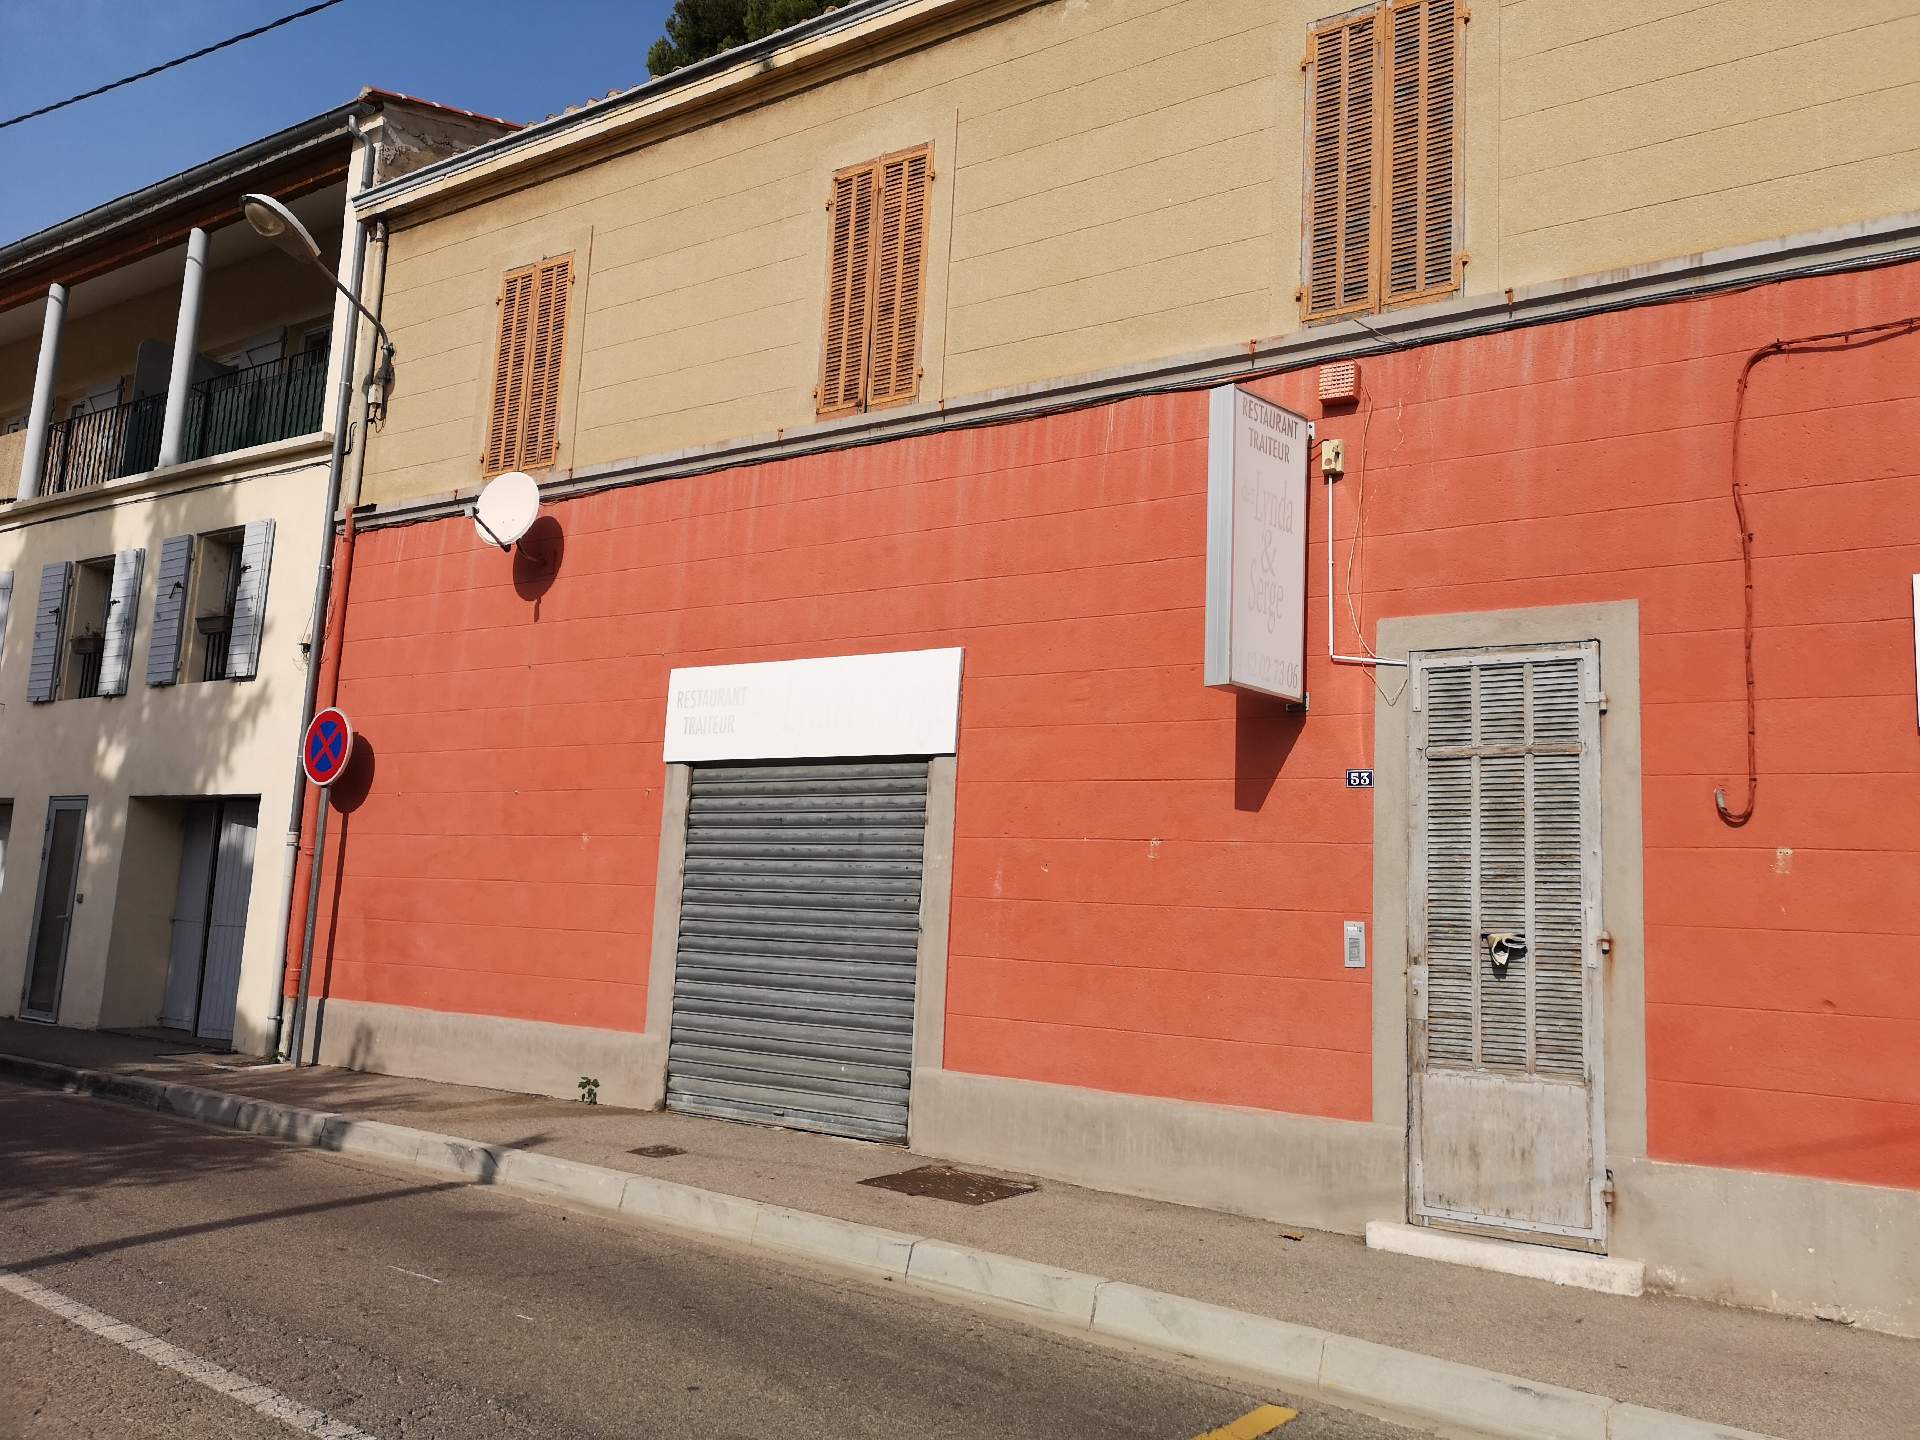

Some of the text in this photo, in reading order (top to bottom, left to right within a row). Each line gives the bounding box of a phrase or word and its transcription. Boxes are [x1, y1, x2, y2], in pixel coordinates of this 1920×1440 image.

[1242, 396, 1298, 440] RESTAURANT
[1248, 427, 1290, 464] TRAITEUR
[1253, 469, 1293, 535] Lynda
[1260, 529, 1277, 577] &
[1248, 559, 1284, 635] Serge
[1286, 662, 1299, 689] 06
[676, 685, 748, 710] RESTAURANT
[682, 714, 736, 736] TRAITEUR
[1350, 772, 1371, 786] 53
